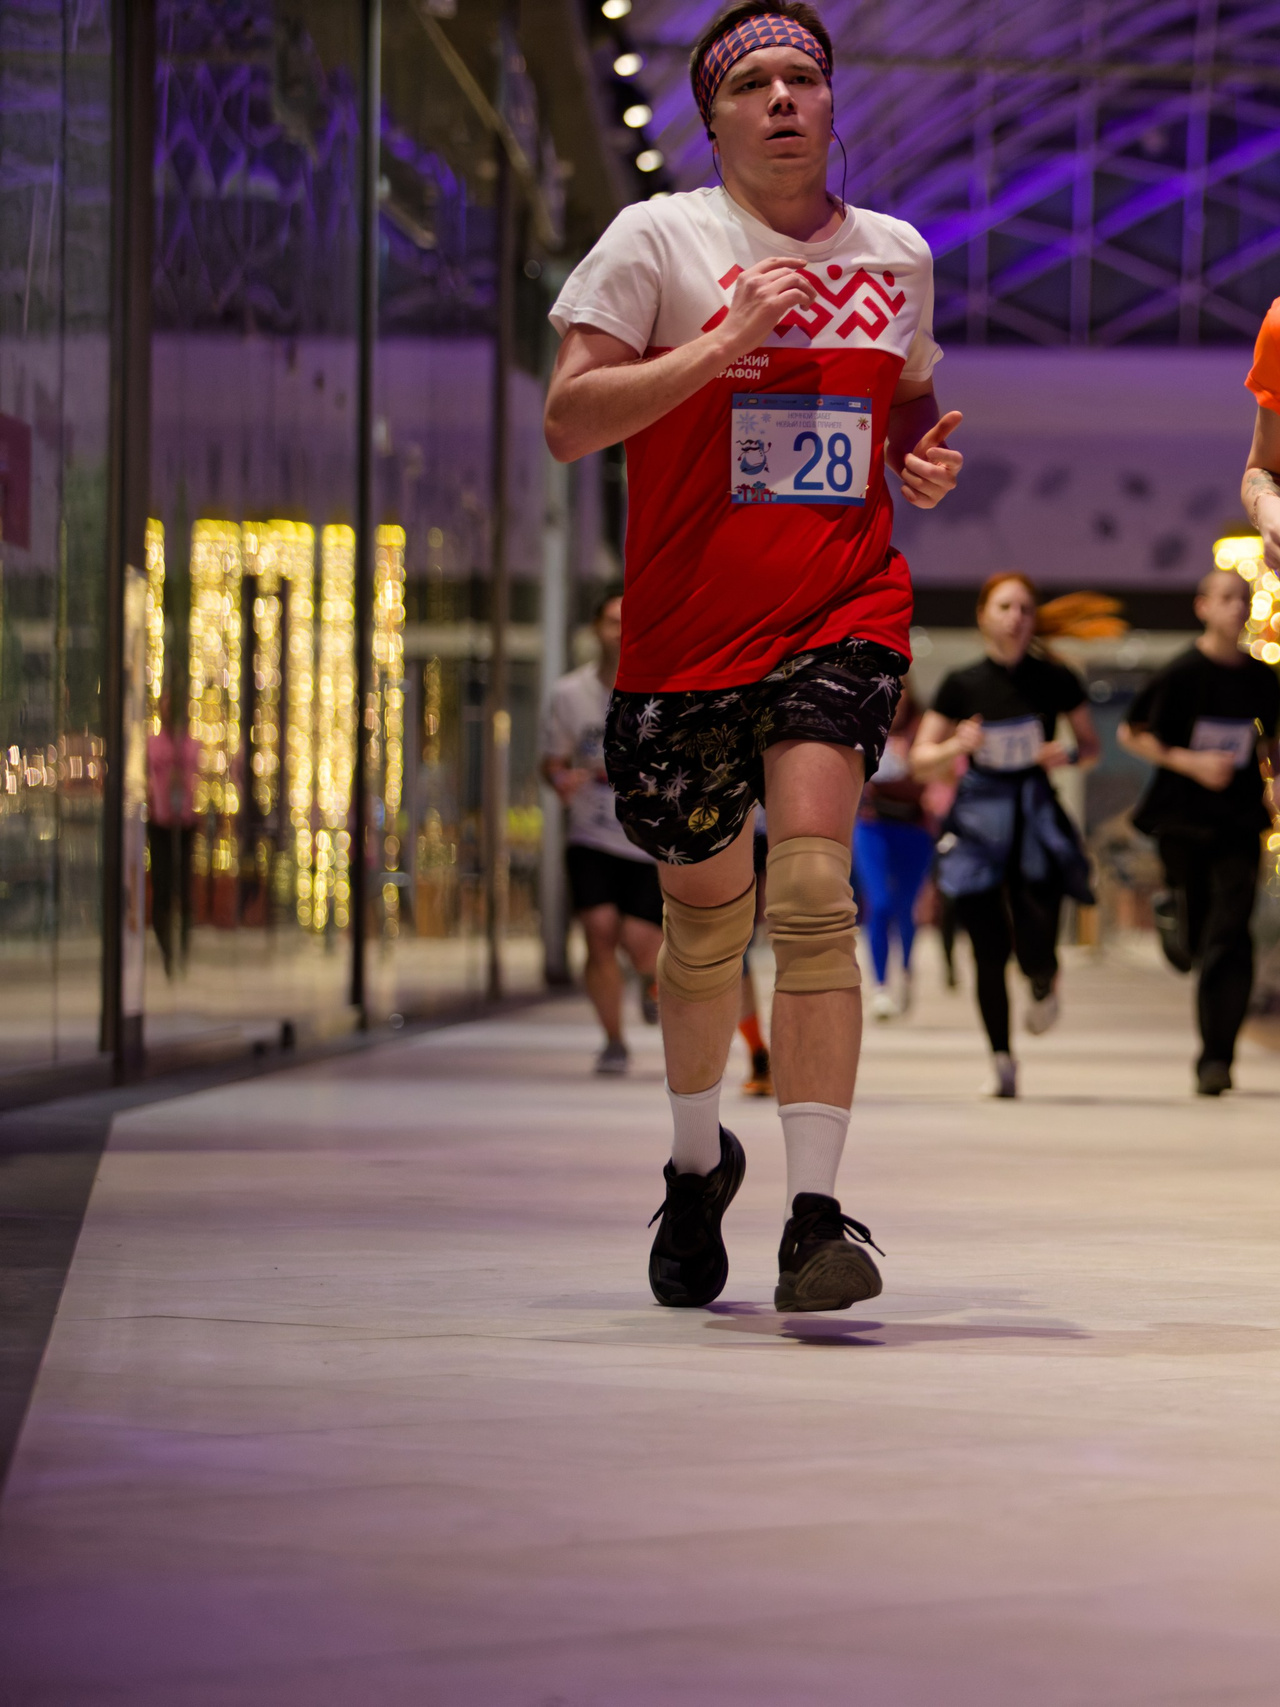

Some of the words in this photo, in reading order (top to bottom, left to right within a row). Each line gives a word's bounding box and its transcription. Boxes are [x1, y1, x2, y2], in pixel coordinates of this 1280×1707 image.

[731, 353, 769, 367] СКИЙ
[715, 367, 761, 380] РАФОН
[793, 431, 853, 492] 28
